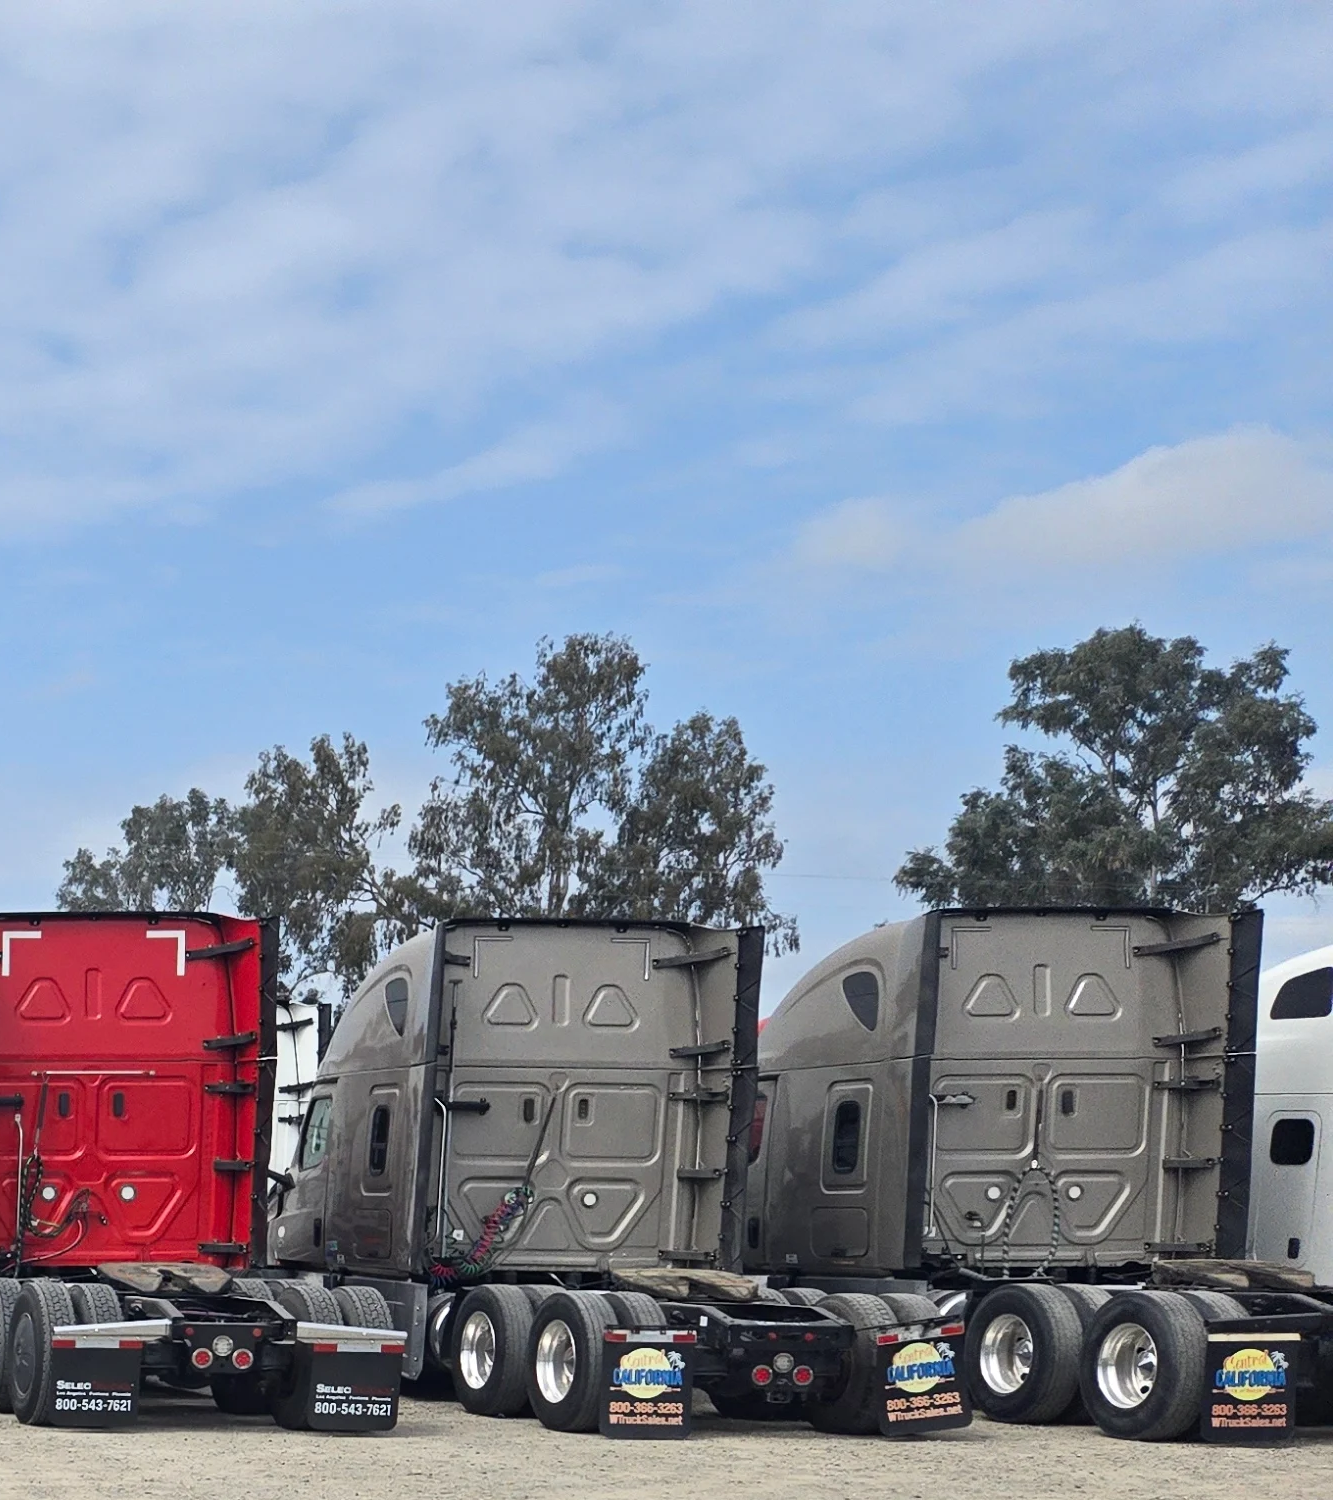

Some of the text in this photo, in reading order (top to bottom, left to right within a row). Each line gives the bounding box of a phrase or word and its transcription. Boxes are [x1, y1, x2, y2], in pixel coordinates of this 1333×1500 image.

[613, 1368, 682, 1385] CALIFORNIA
[887, 1360, 955, 1383] CALIFORNIA
[1216, 1369, 1286, 1387] CALIFORNIA
[56, 1398, 131, 1411] 800-543-7621
[315, 1402, 391, 1416] 800-543-7621
